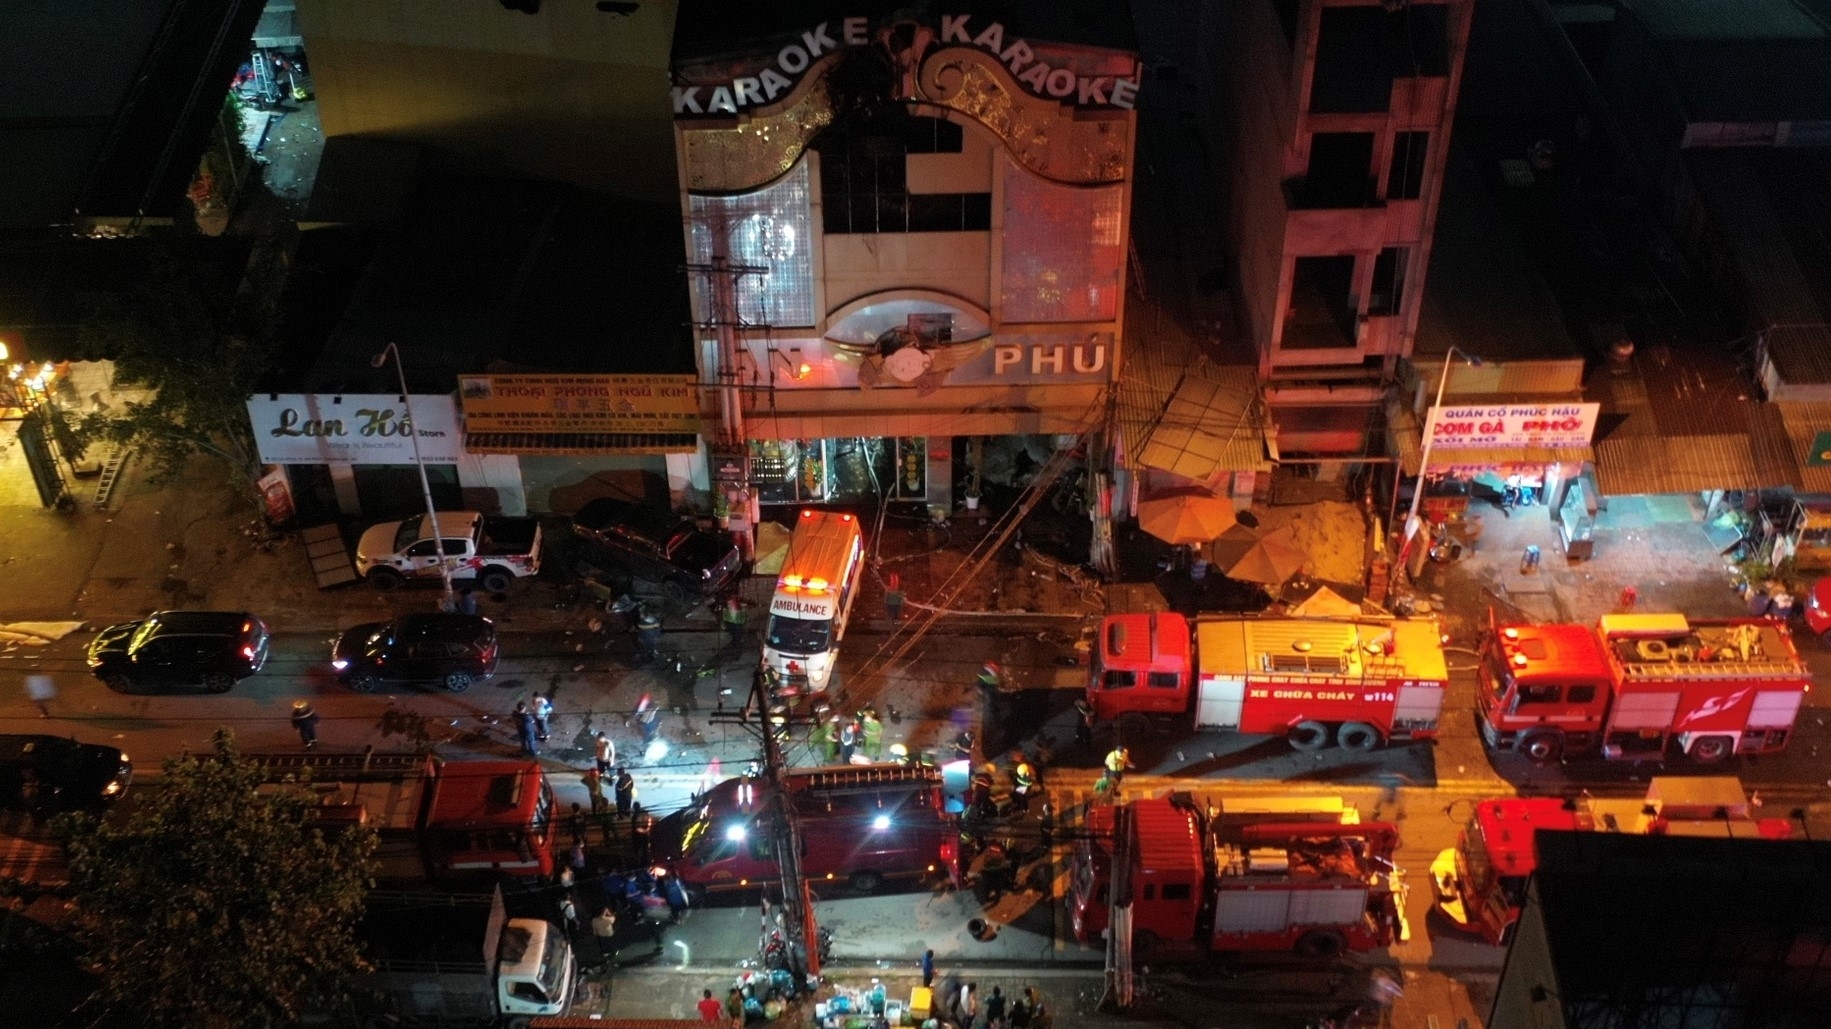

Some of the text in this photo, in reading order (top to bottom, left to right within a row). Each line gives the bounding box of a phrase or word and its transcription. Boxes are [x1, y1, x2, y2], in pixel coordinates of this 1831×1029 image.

[673, 16, 868, 114] KARAOKE
[941, 14, 1139, 109] KARAOKE
[994, 336, 1105, 375] PHÚ
[555, 386, 610, 397] PHONG
[661, 387, 688, 397] KIM
[1445, 408, 1484, 419] QUÁN
[270, 408, 348, 437] Lan
[1478, 418, 1505, 435] GÀ
[1522, 417, 1583, 431] PHỞ
[418, 429, 446, 437] Store
[772, 600, 828, 616] AMBULANCE
[1250, 689, 1268, 698] XE
[1317, 690, 1355, 700] CHÁY
